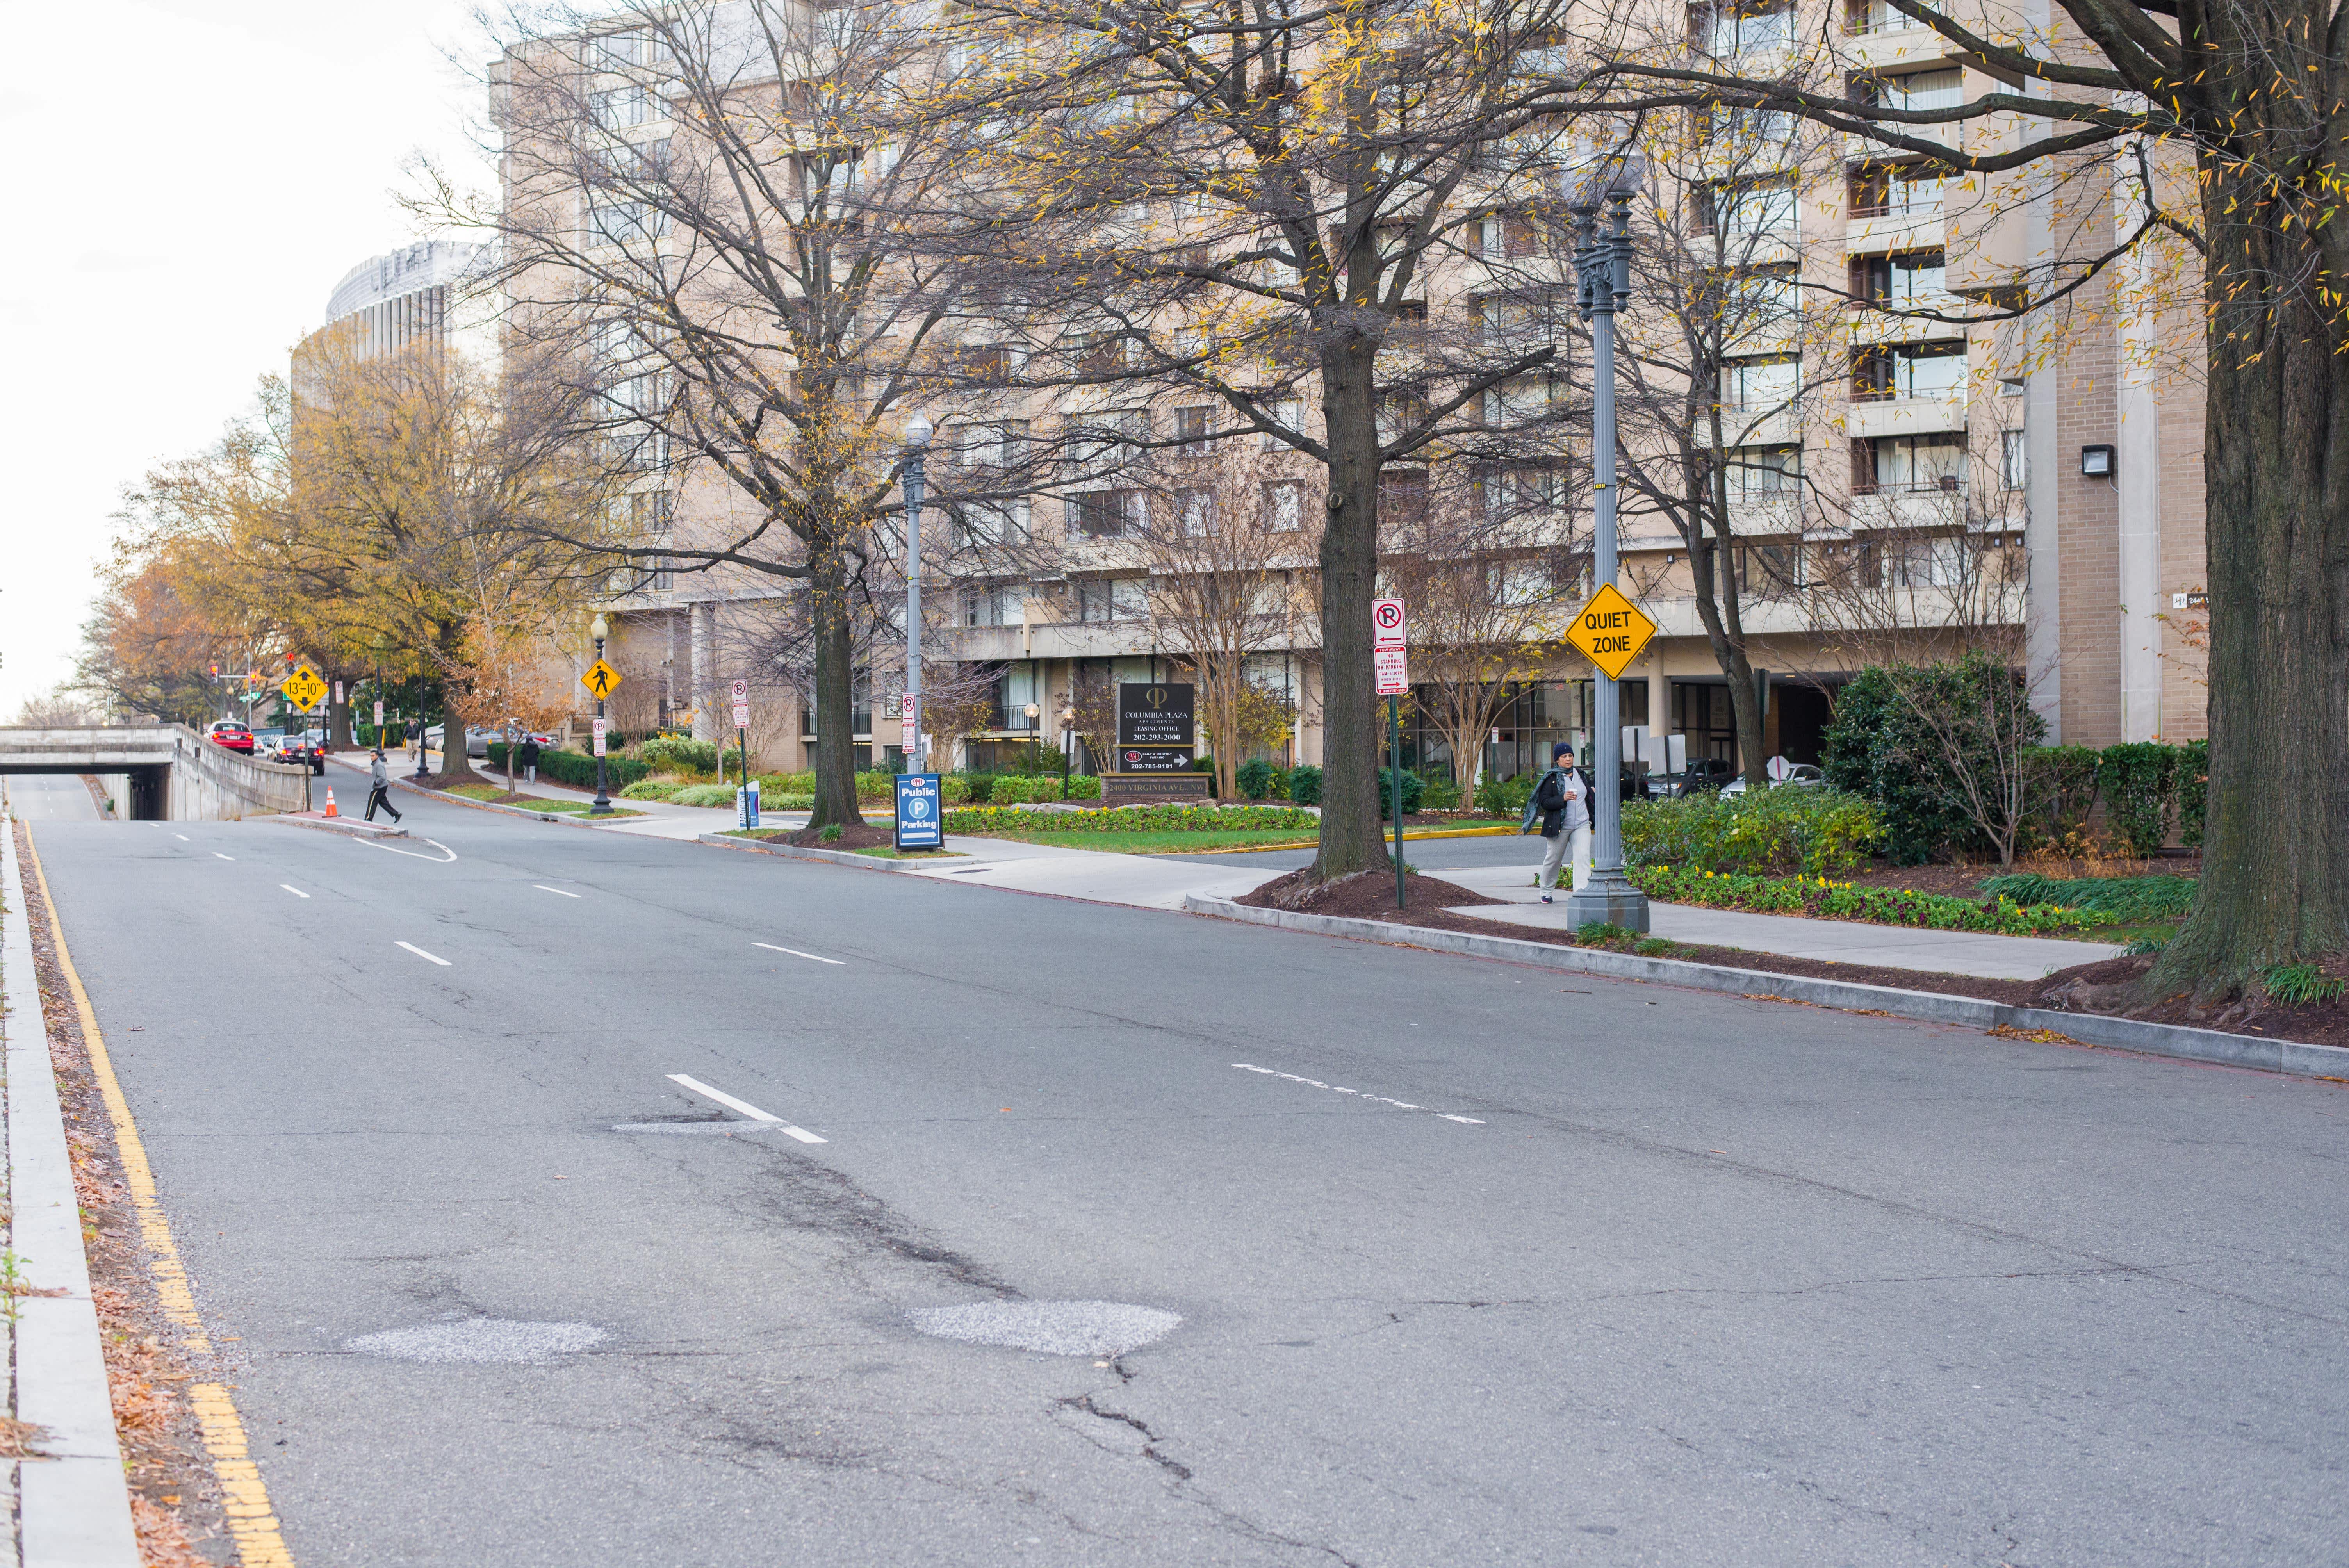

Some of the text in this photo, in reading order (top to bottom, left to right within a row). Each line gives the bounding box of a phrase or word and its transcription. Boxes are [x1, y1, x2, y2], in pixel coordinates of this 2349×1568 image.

[1585, 611, 1631, 630] QUIET
[1593, 636, 1631, 654] ZONE
[902, 787, 935, 797] Public
[901, 820, 937, 829] Parking
